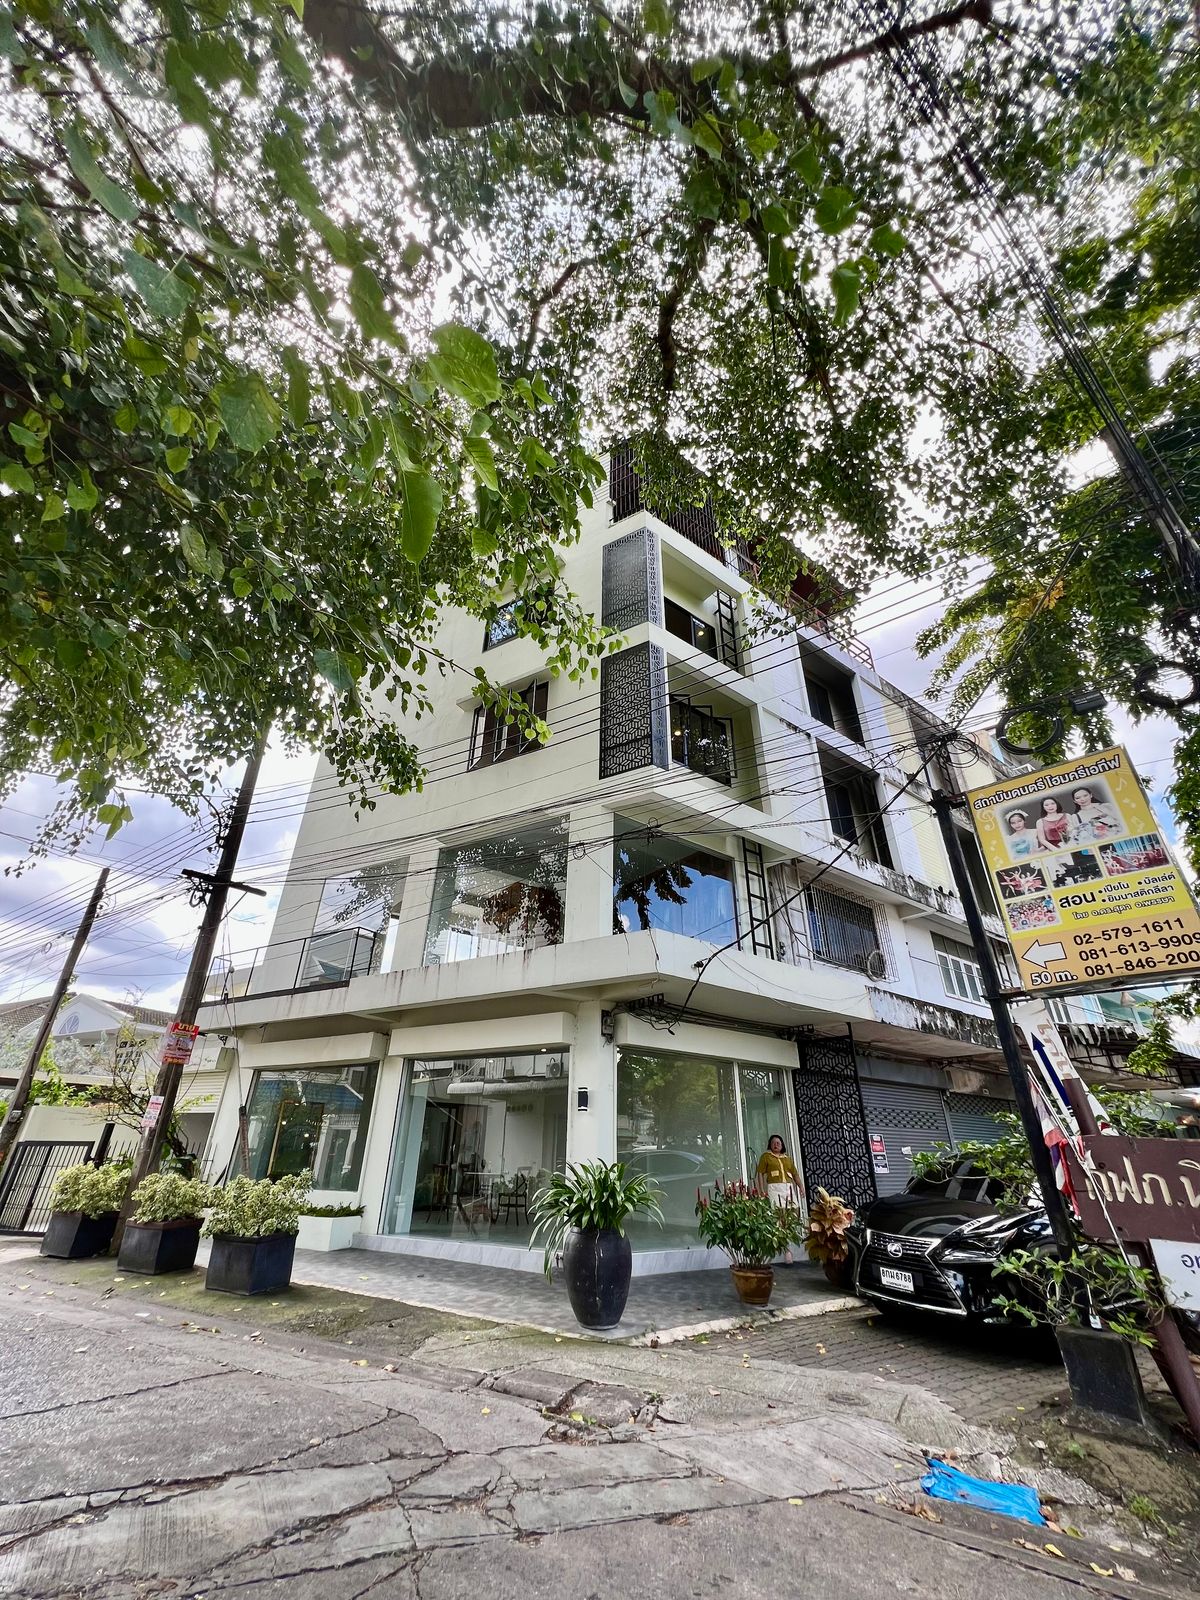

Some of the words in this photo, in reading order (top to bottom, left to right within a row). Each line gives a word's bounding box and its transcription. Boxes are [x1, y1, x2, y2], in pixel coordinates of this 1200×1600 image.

[974, 778, 1046, 810] สถาบันดนตรี
[1046, 754, 1121, 789] โฮมครีเอทีฟ
[1059, 891, 1097, 909] สอน
[1073, 917, 1185, 946] 02-579-1611
[1079, 931, 1200, 962] 081-613-9909
[1031, 972, 1052, 986] 50
[1054, 970, 1078, 982] m.
